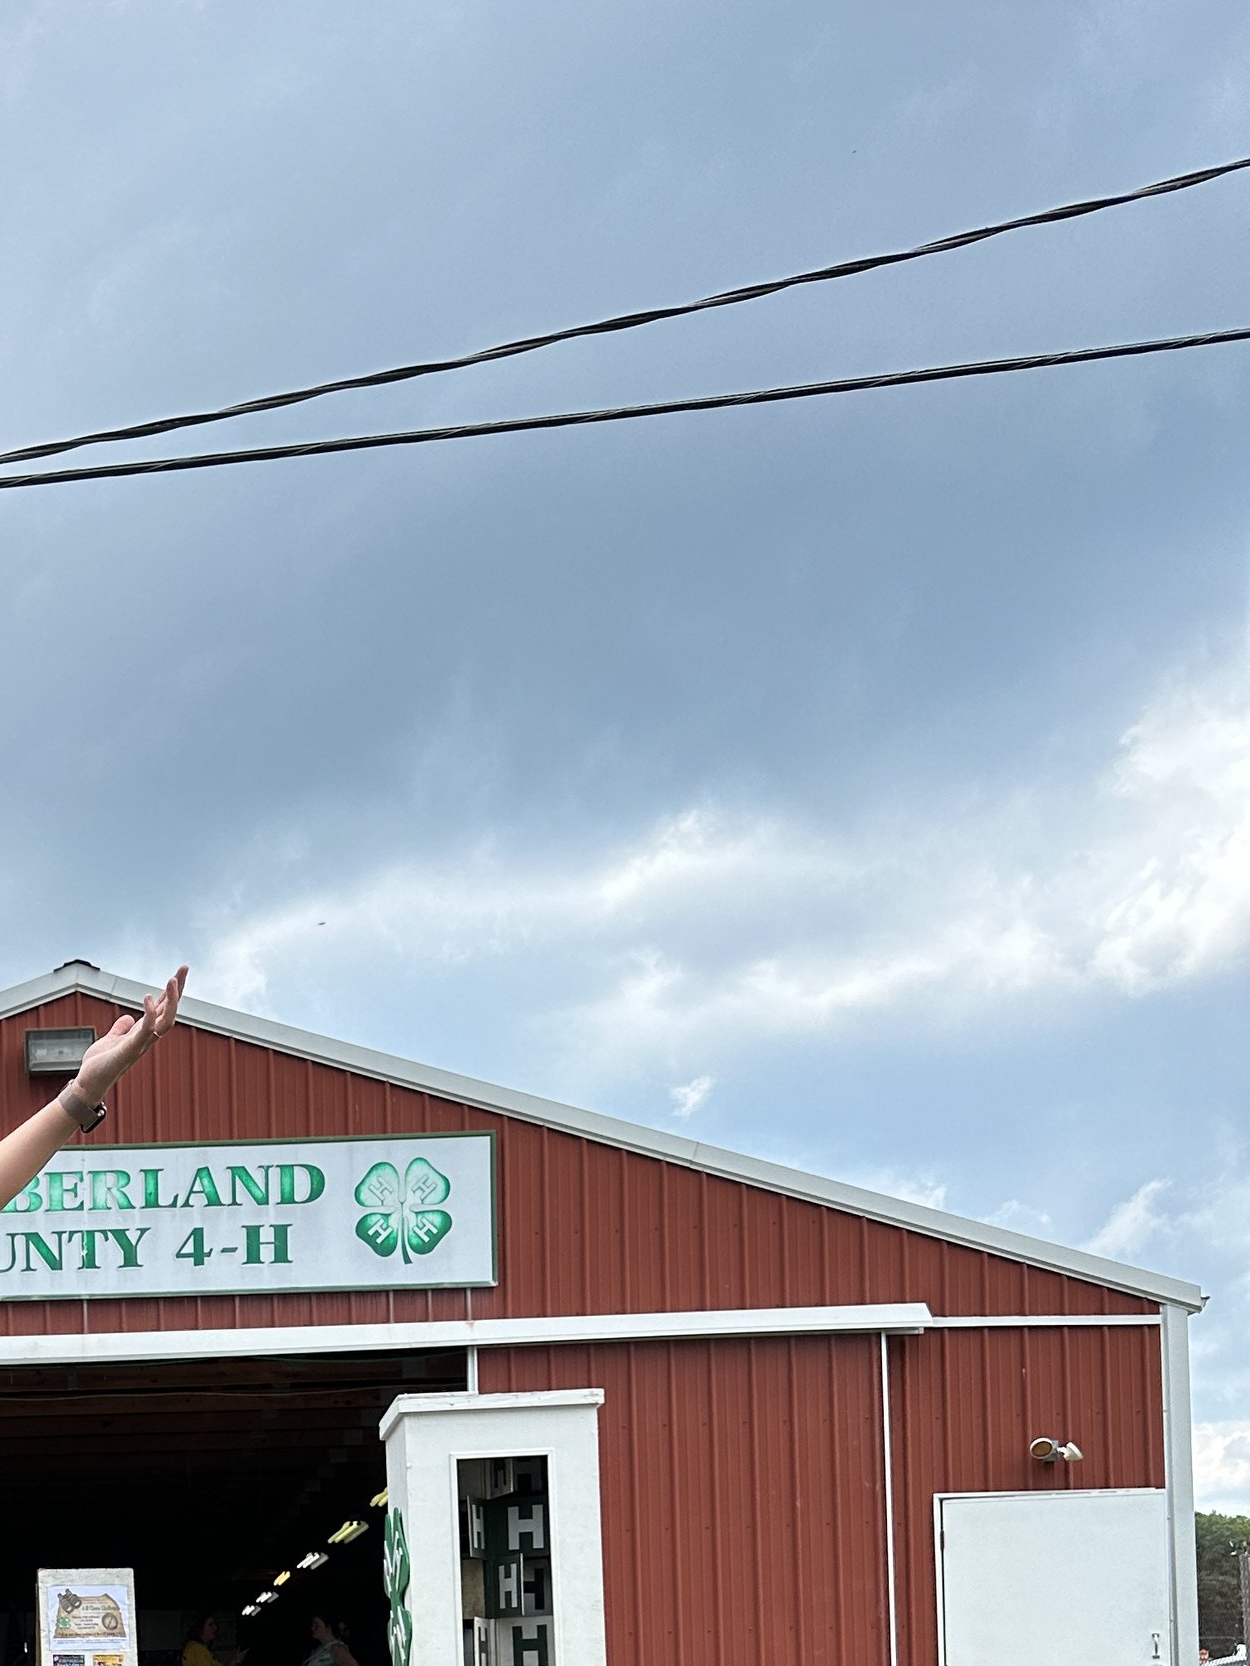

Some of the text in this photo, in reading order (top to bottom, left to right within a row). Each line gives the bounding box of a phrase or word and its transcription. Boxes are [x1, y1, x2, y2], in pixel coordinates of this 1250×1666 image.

[175, 1223, 294, 1267] 4-H
[508, 1504, 544, 1550] H
[499, 1563, 518, 1609] H
